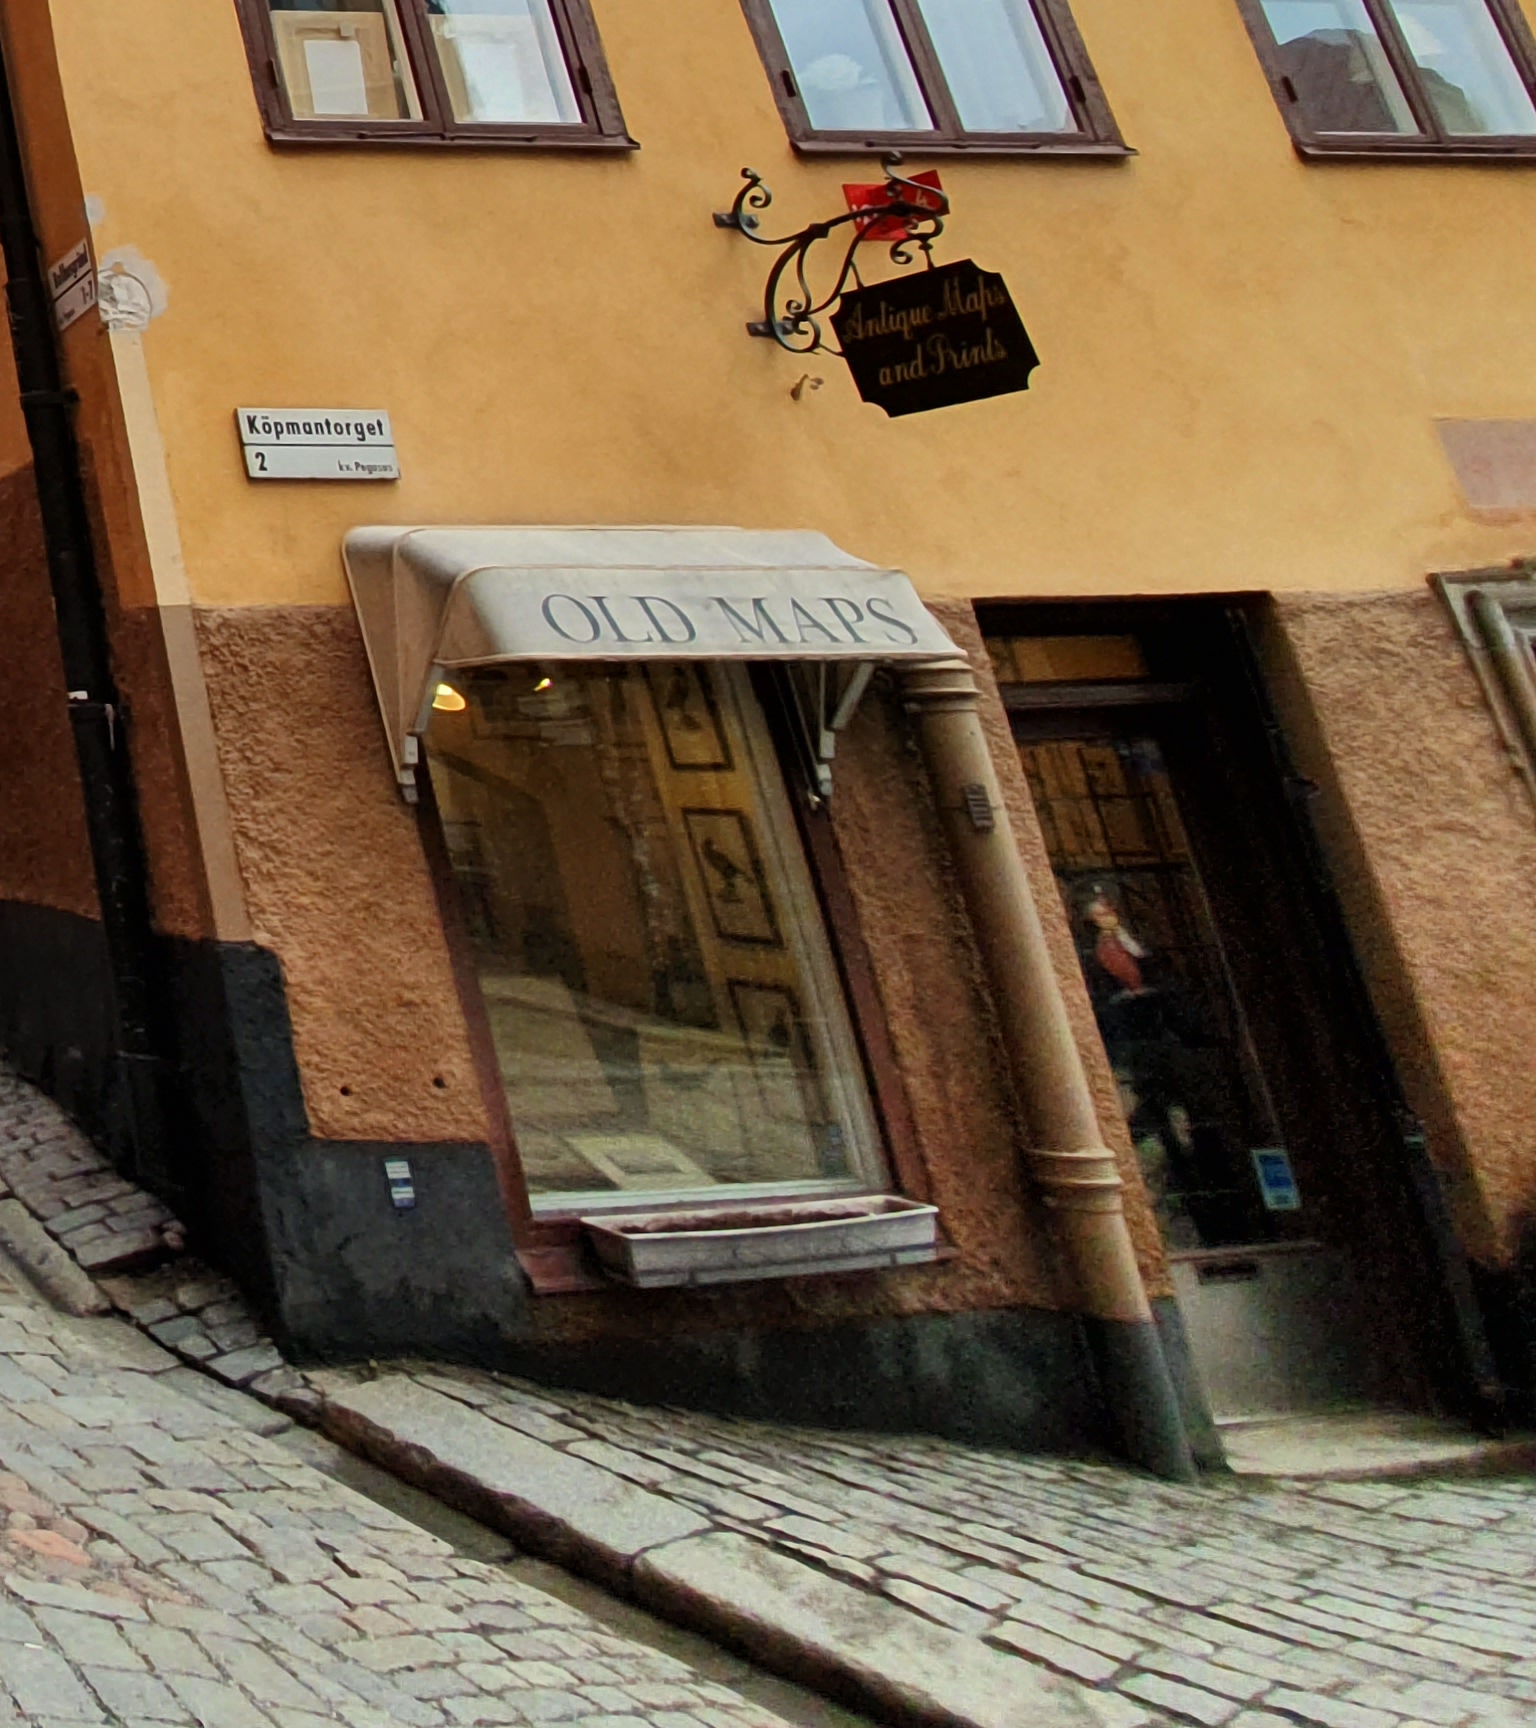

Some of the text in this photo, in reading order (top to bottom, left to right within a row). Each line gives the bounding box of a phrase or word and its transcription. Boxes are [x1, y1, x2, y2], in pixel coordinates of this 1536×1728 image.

[843, 274, 1006, 343] Antique Maps
[879, 326, 1008, 386] and Prints
[246, 415, 384, 442] Köpmantorget
[255, 452, 268, 471] 2
[540, 593, 920, 646] OLD MAPS
